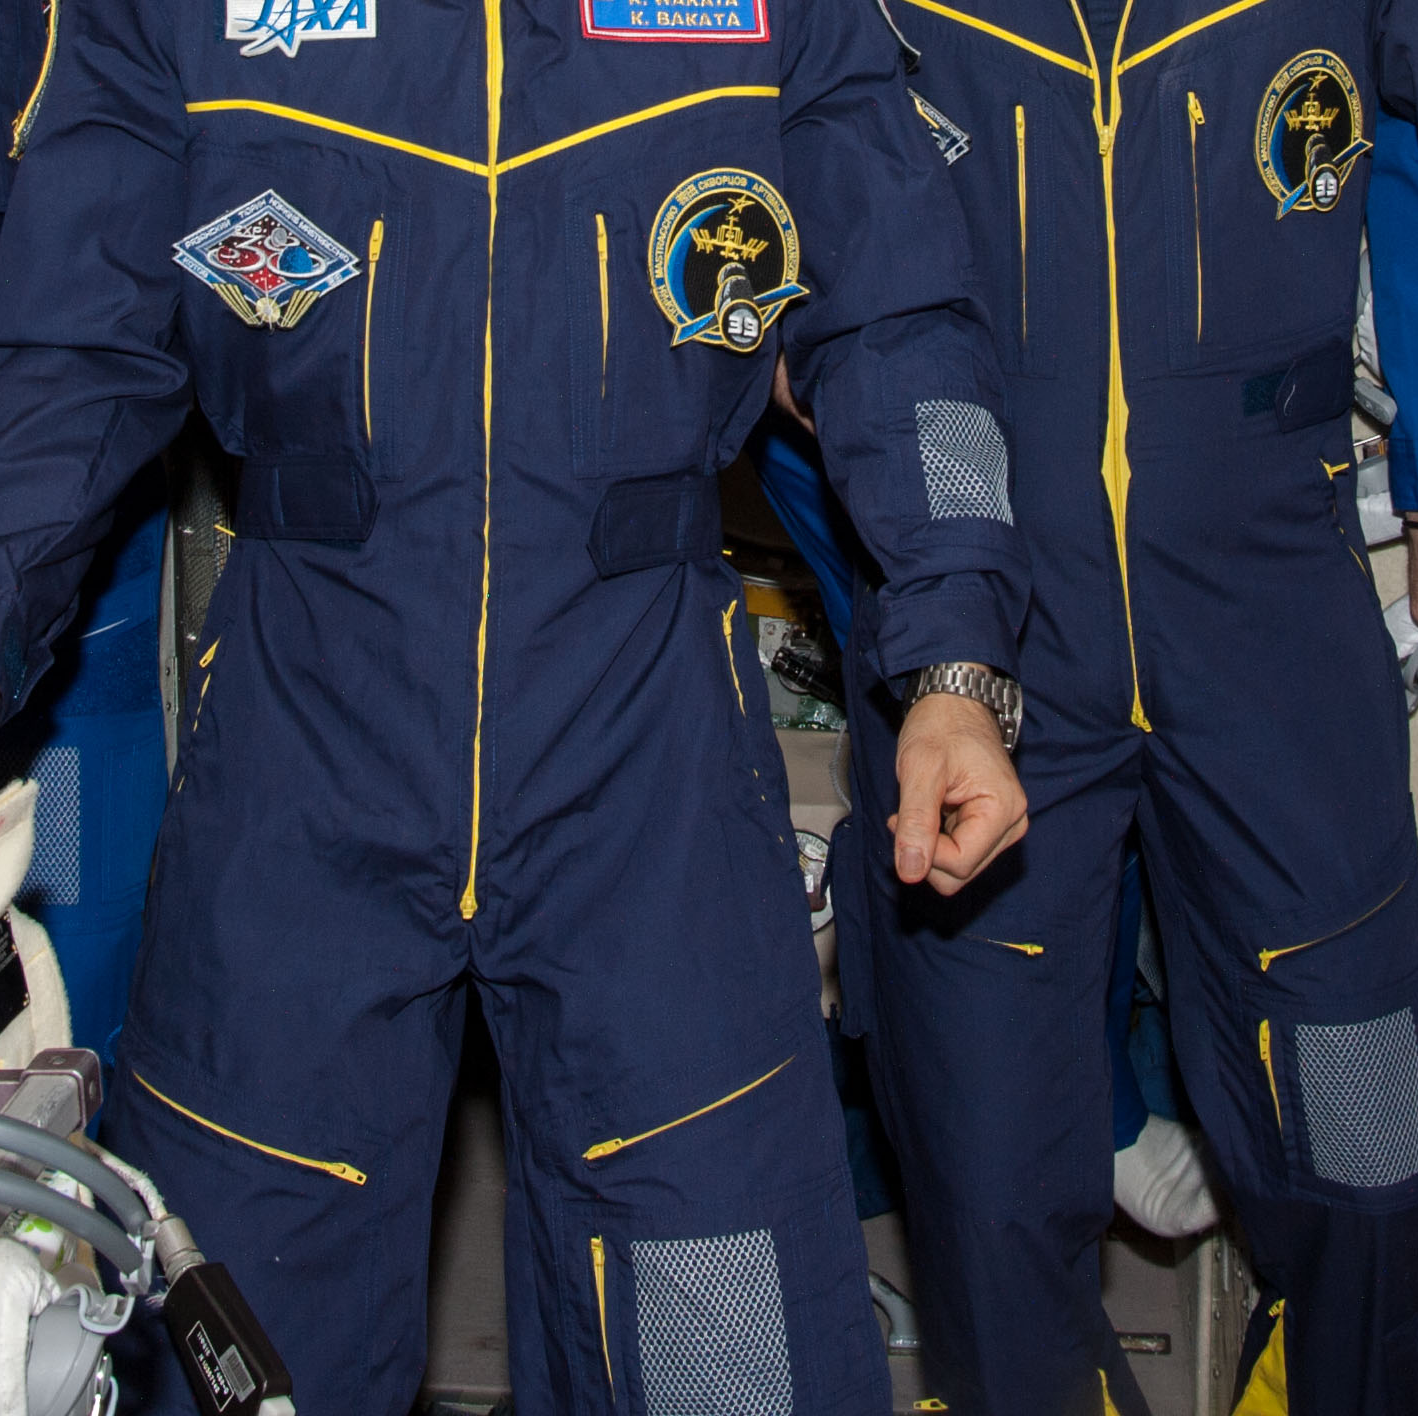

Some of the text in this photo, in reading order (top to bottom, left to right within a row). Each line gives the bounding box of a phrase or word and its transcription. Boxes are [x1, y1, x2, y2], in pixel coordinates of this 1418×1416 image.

[657, 10, 742, 28] ВАКАТА
[699, 176, 748, 191] СКВОРЦОВ
[1316, 178, 1338, 197] 39
[269, 197, 350, 264] HOPKINS MASTRACCHIO
[655, 206, 679, 278] MASTRACCHIO
[207, 228, 328, 279] 38
[728, 315, 759, 338] 39
